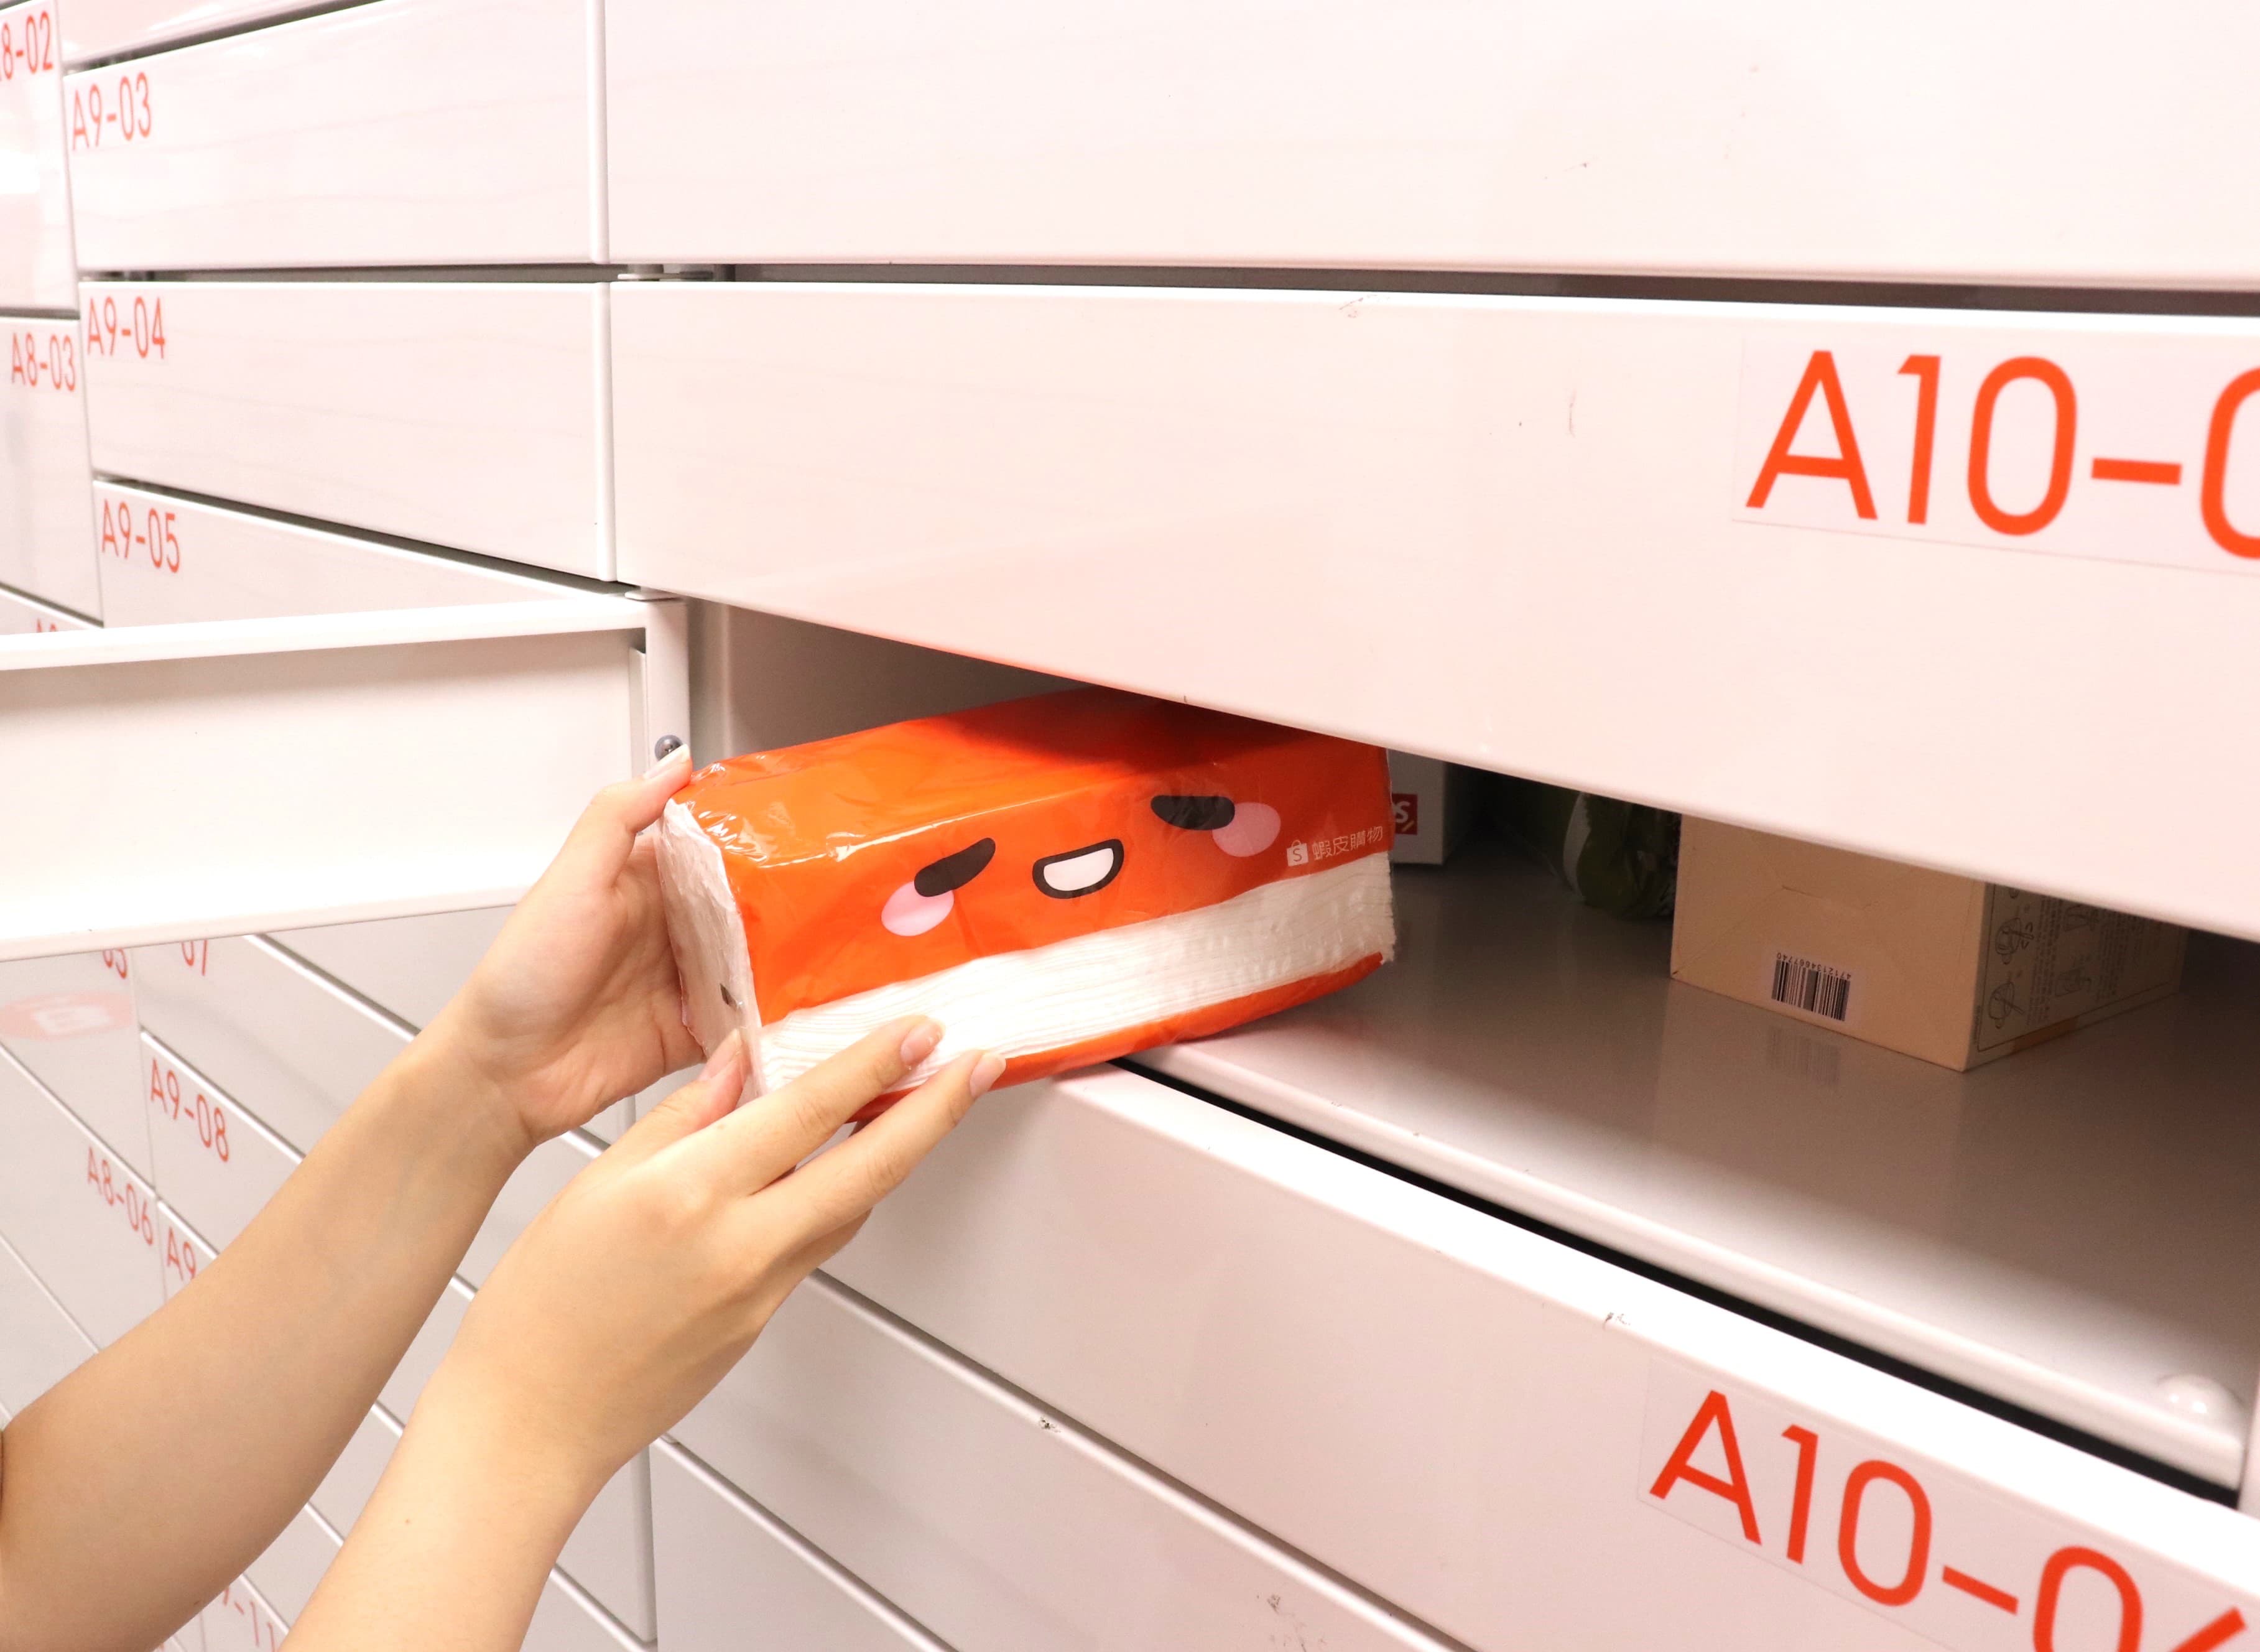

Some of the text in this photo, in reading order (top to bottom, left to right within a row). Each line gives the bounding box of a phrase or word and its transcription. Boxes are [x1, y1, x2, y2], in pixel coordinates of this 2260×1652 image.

[0, 10, 54, 81] 8-02
[72, 72, 152, 151] A9-03
[11, 333, 76, 391] A8-03
[87, 296, 166, 359] A9-04
[101, 499, 181, 573] A9-05
[1312, 825, 1383, 861] 蝦皮購物
[149, 1059, 229, 1162] A9-08
[87, 1146, 154, 1245] A8-06
